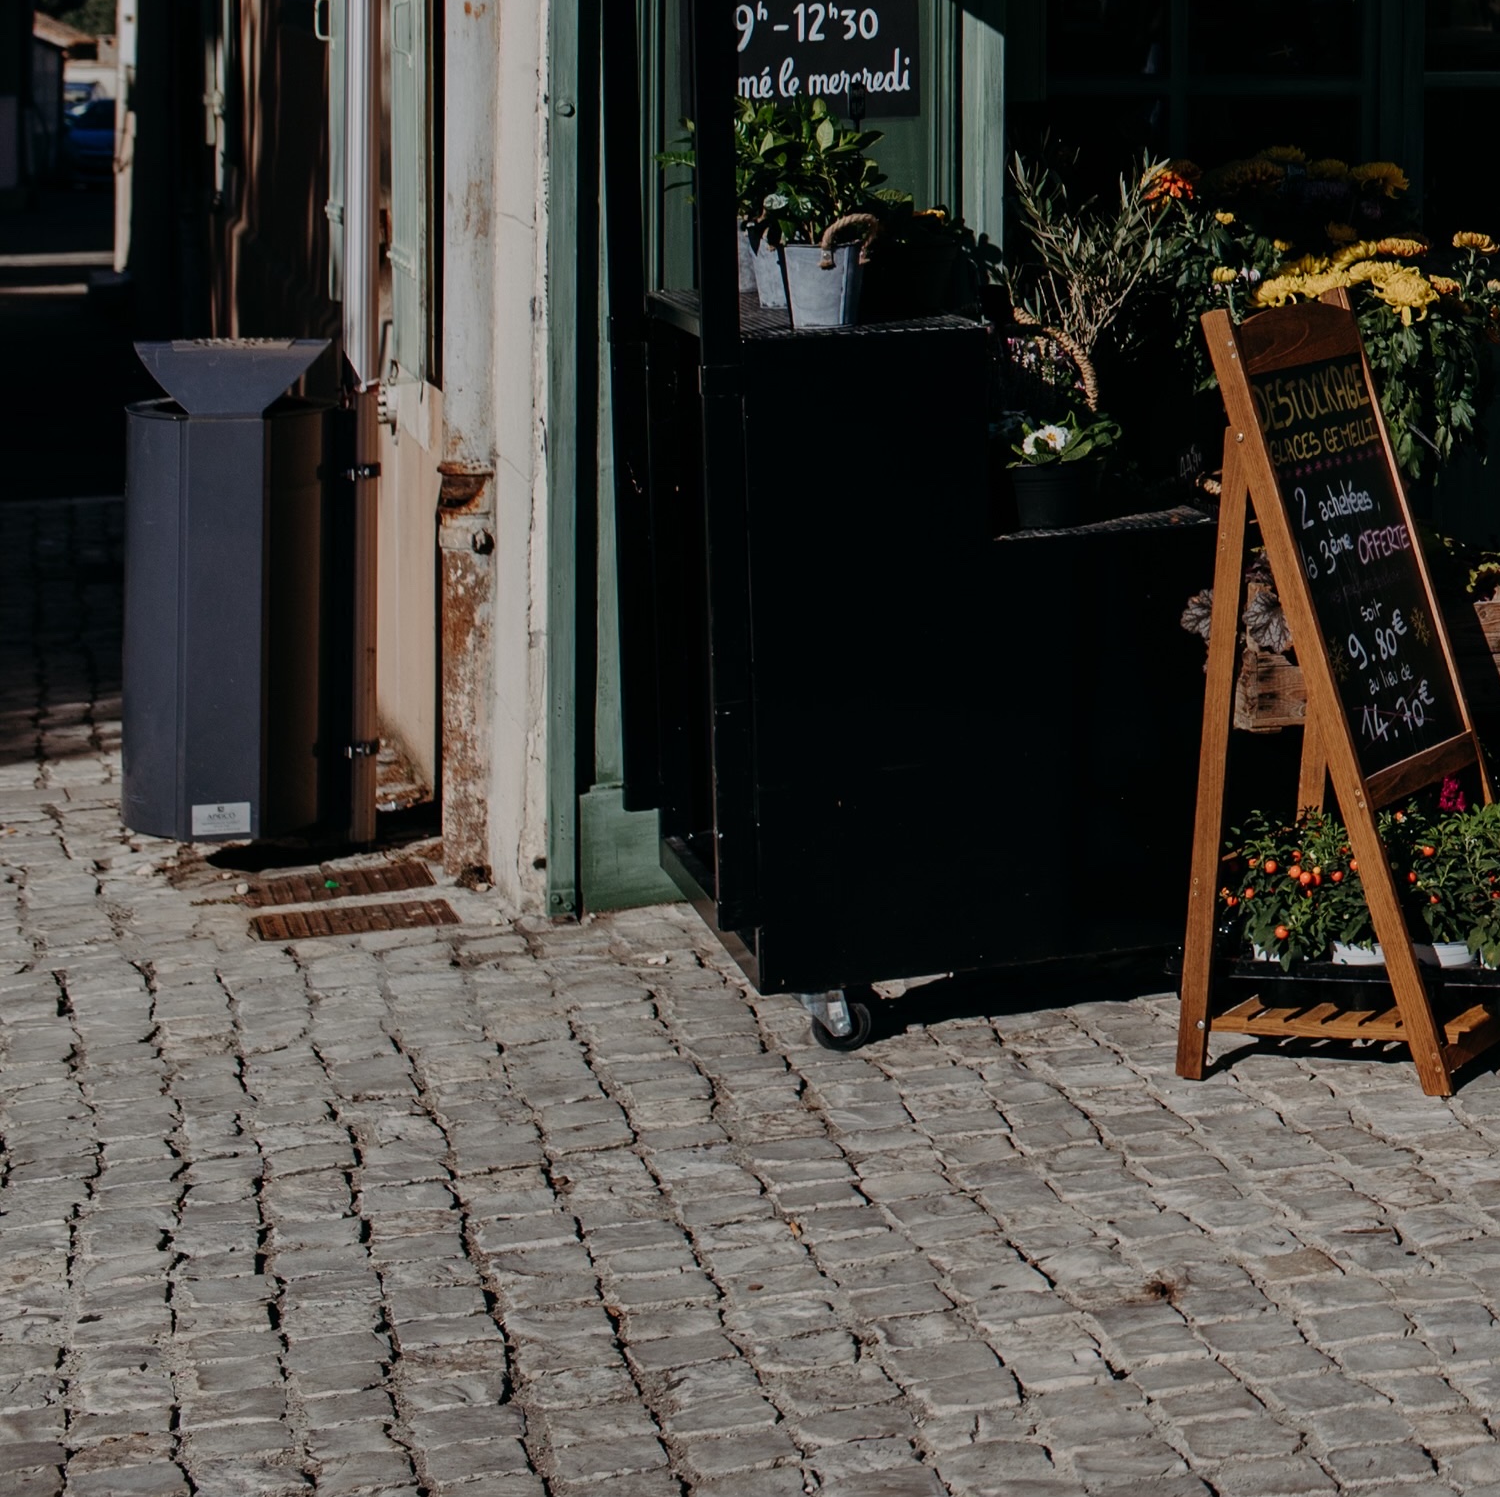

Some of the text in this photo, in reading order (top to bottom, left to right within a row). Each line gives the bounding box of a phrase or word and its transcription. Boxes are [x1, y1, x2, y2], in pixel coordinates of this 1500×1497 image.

[779, 56, 800, 98] le
[1252, 363, 1370, 432] DESTOCKAGE
[1269, 417, 1379, 467] GLACES GEMELLI
[1294, 486, 1315, 531] 2
[1299, 523, 1411, 580] la 3ème OFFERTE
[1360, 598, 1382, 622] soit
[1369, 663, 1414, 696] au lieu de
